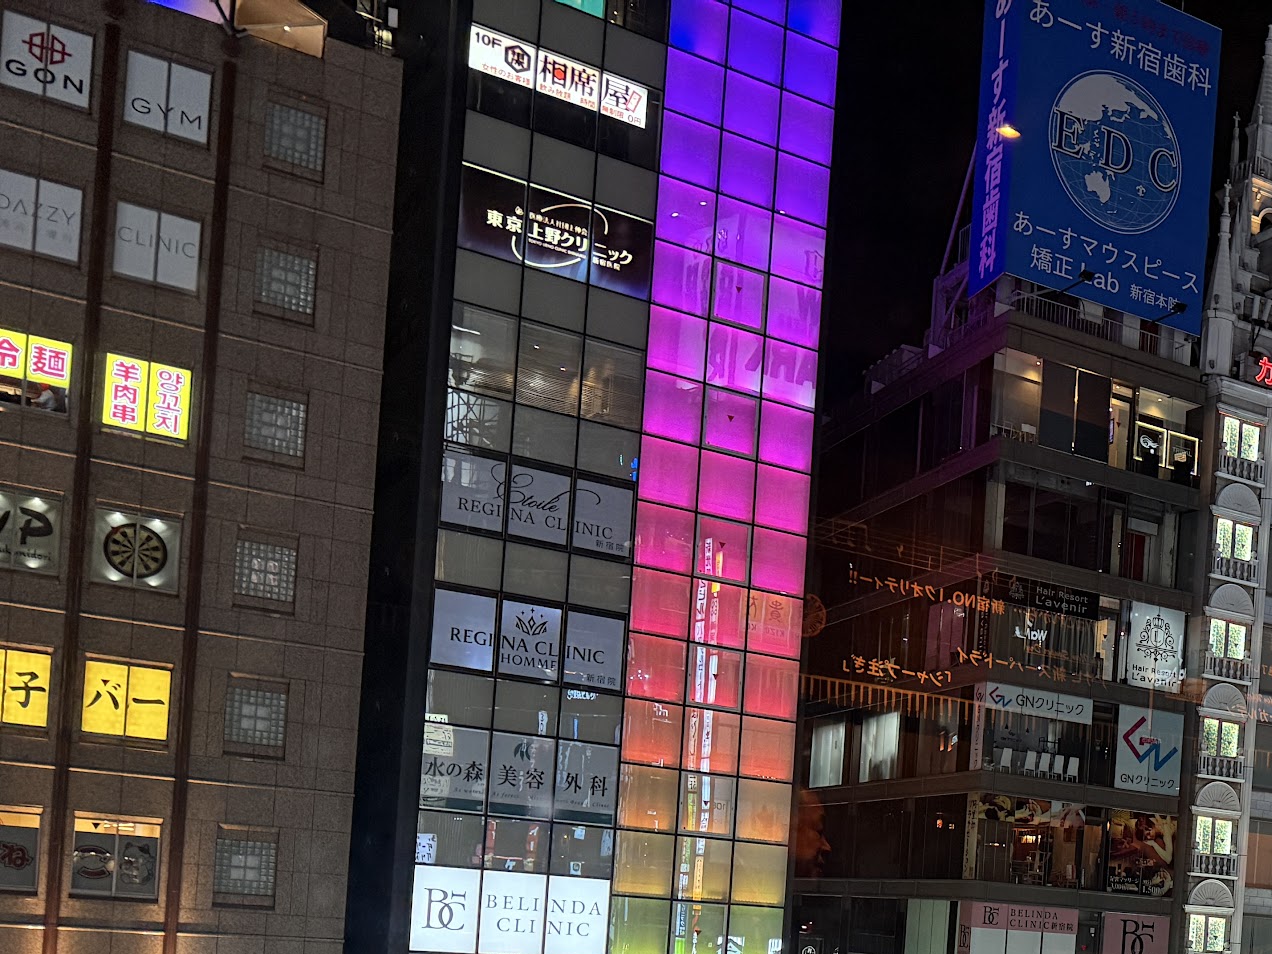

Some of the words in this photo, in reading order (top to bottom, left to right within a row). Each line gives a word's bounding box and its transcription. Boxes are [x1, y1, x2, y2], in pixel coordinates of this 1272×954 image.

[475, 31, 502, 49] 10F
[1029, 0, 1212, 96] あーす新宿歯科
[5, 59, 84, 94] GON
[539, 54, 631, 112] 相席屋
[131, 97, 202, 130] GYM
[117, 226, 197, 259] CLINIC
[486, 208, 634, 266] 東京上野クリニック
[1013, 211, 1199, 294] あーすマウスピース
[1030, 243, 1073, 280] 矯正
[112, 361, 141, 424] 羊肉串
[154, 370, 186, 434] 양꼬치
[457, 496, 536, 526] REGINA
[544, 514, 614, 540] CLINIC
[595, 539, 625, 553] 新宿院
[1035, 595, 1088, 614] L'avenir
[1036, 586, 1056, 597] Hair
[1058, 590, 1089, 604] Resort
[449, 626, 529, 653] REGINA
[534, 639, 605, 665] CLINIC
[501, 652, 557, 671] HOMME
[1132, 663, 1149, 673] Hair
[1015, 694, 1085, 716] GNクリニック
[1120, 773, 1175, 790] GNクリニック
[485, 893, 602, 917] BELINDA
[1010, 908, 1058, 920] BELINDA
[496, 917, 590, 938] CLINIC
[1010, 918, 1050, 930] CLINIC
[1050, 921, 1074, 932] 新宿院
